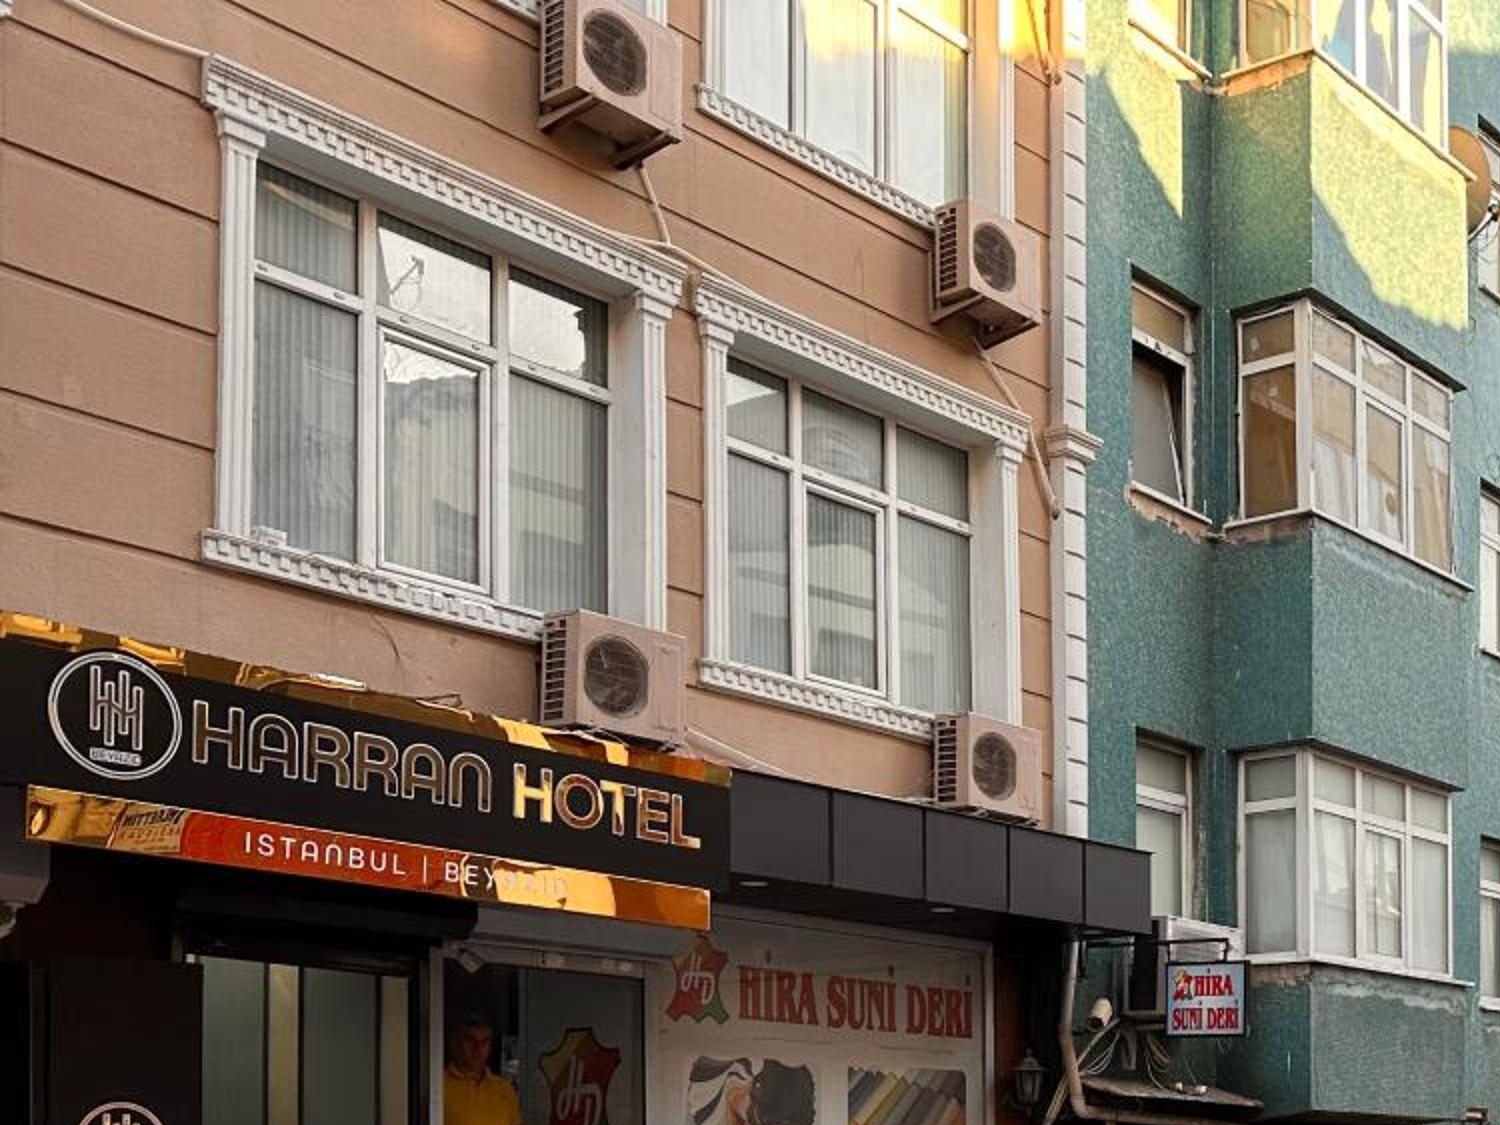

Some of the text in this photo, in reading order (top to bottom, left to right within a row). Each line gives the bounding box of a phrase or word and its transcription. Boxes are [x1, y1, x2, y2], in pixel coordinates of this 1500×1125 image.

[192, 700, 491, 813] HARRAN
[513, 763, 701, 848] HOTEL
[245, 831, 406, 876] ISTANBUL
